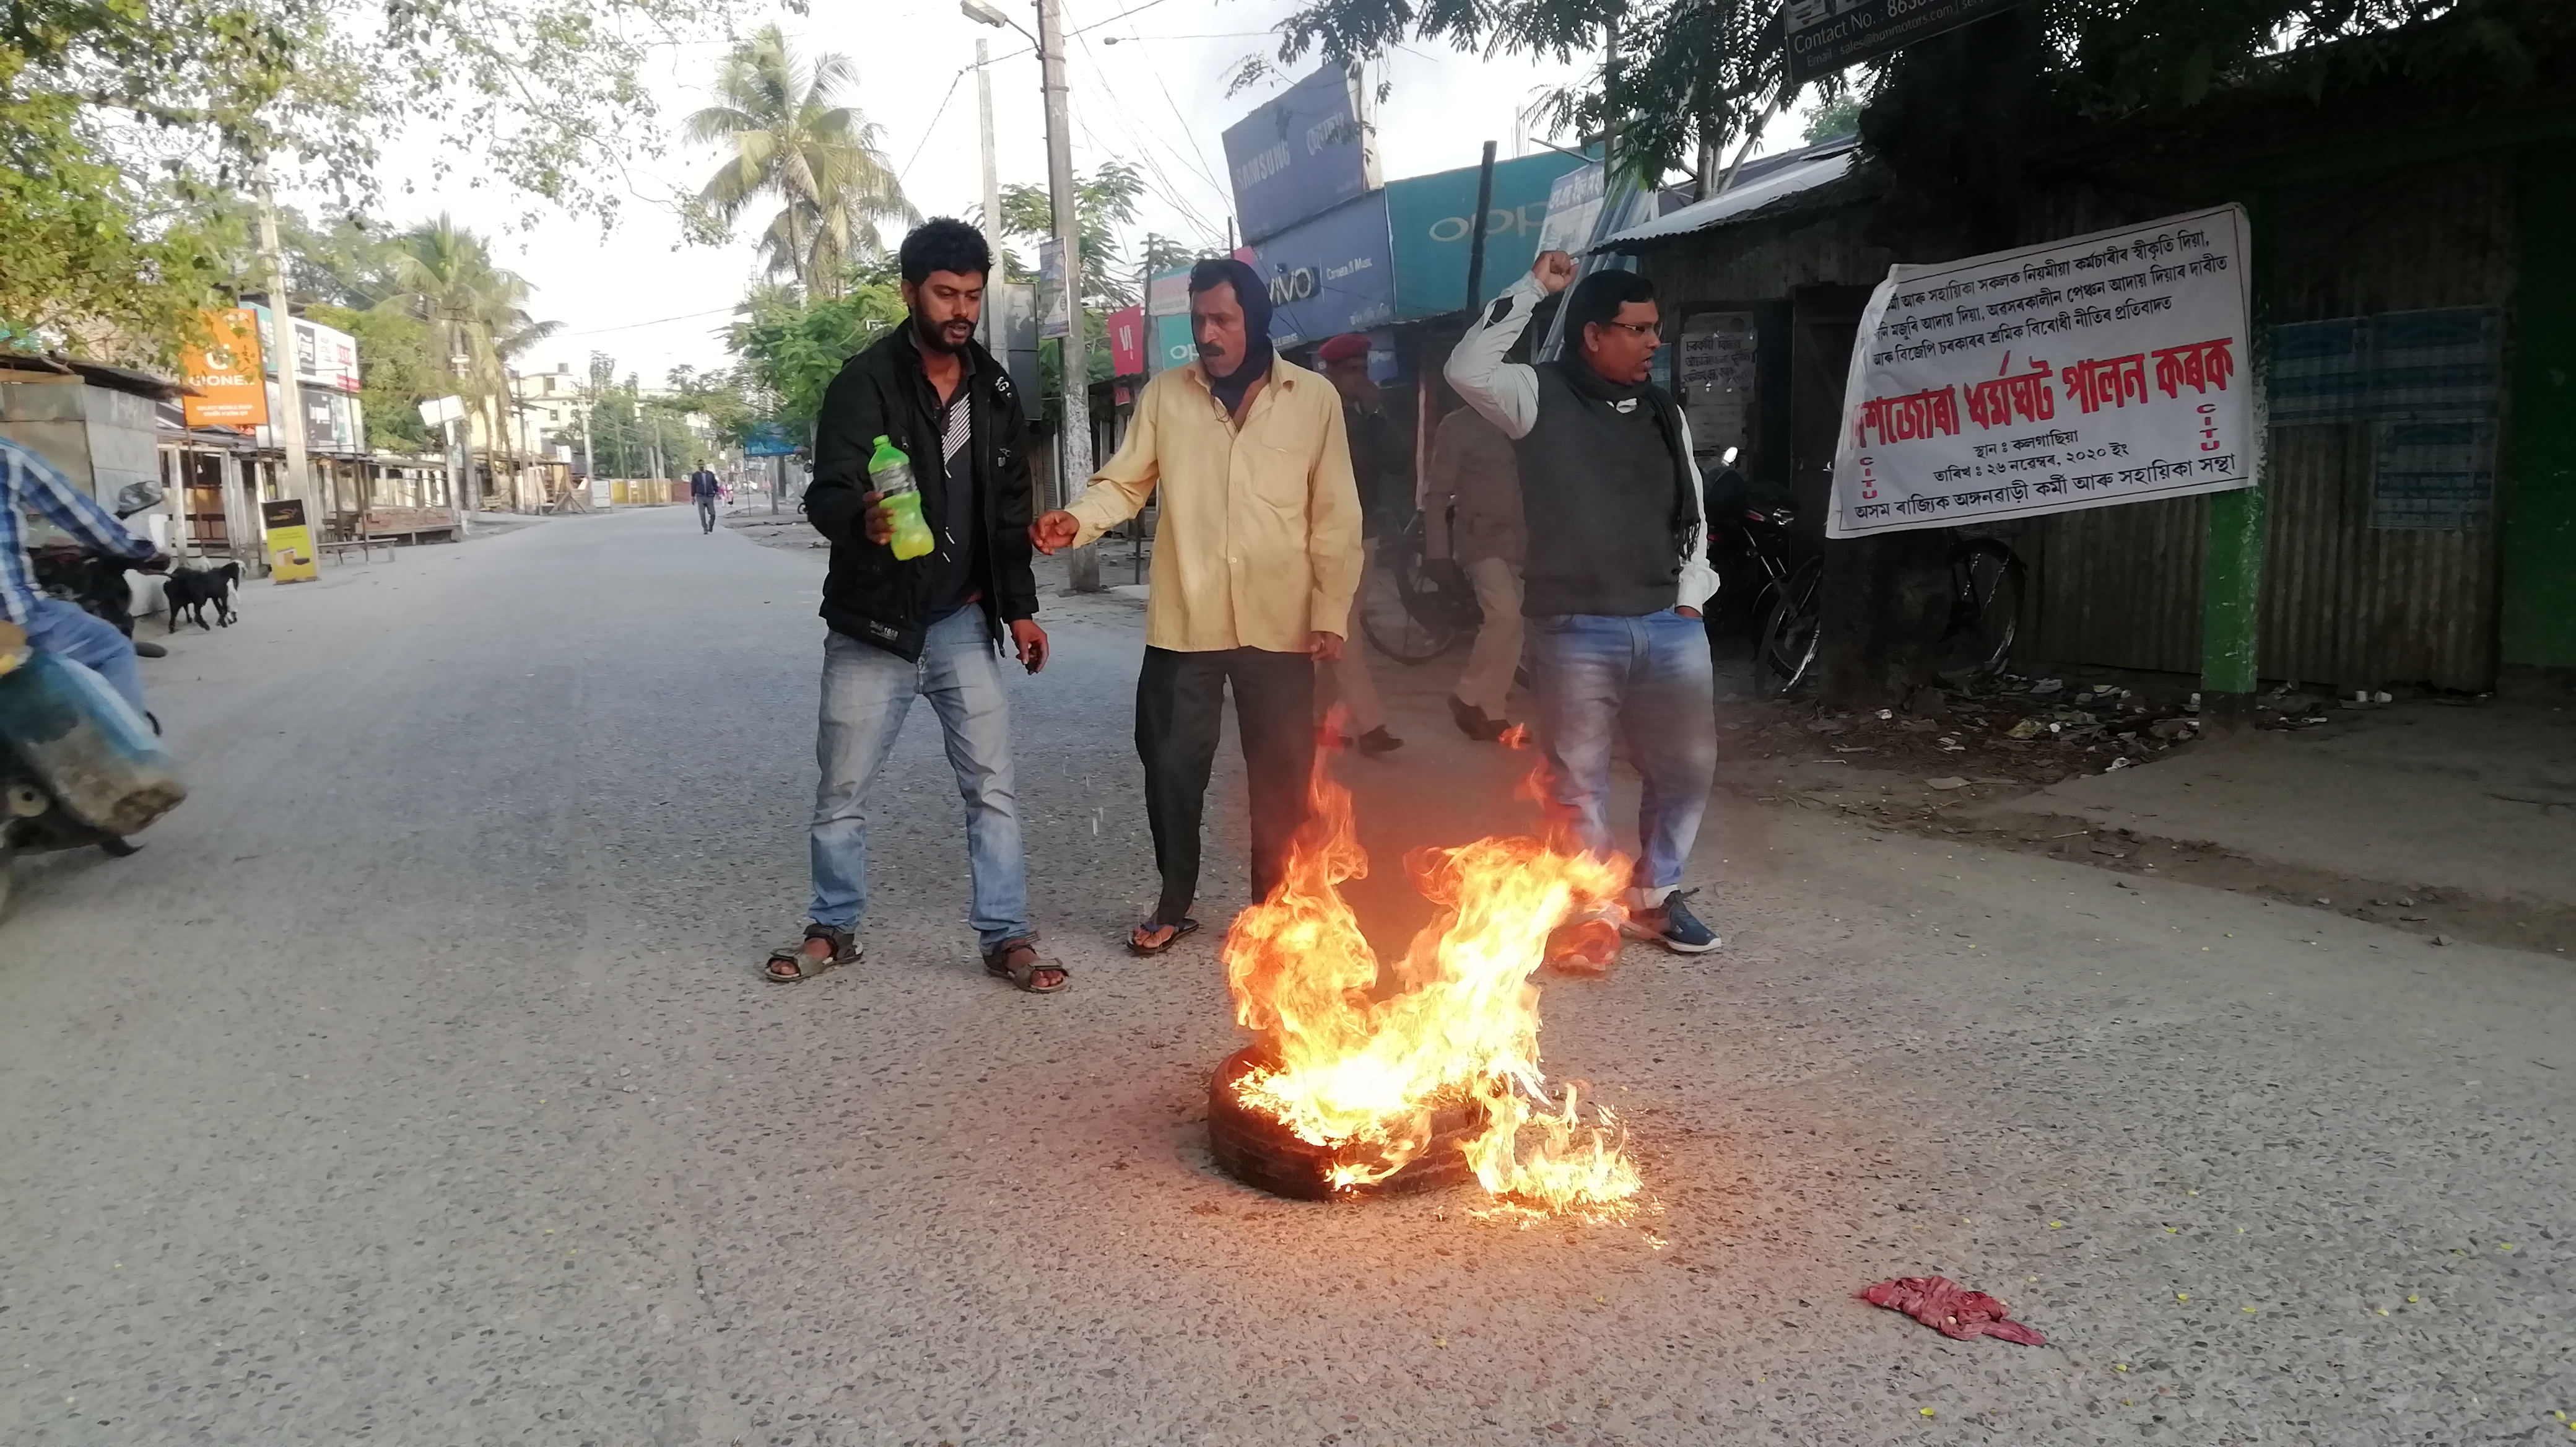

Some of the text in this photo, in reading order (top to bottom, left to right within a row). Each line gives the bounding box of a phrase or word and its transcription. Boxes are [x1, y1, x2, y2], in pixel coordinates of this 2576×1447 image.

[1794, 20, 1848, 55] Contact
[1850, 11, 1876, 32] No.
[1806, 50, 1833, 67] Email
[1235, 140, 1291, 191] SAMSUNG
[1429, 201, 1548, 242] OPP
[1901, 292, 1925, 307] আৰু
[1928, 280, 1975, 302] সহায়িকা
[1978, 271, 2021, 290] সকলক
[2073, 246, 2128, 271] কৰ্মচাৰীৰ
[1920, 312, 1953, 330] আদায়
[2108, 273, 2147, 292] আদায়
[2149, 264, 2186, 286] দিয়াৰ
[1895, 338, 1937, 362] বিজেপি
[2074, 305, 2112, 328] নীতিৰ
[2062, 353, 2148, 414] পালন
[2151, 338, 2234, 399] কৰক
[1933, 465, 1972, 482] তাৰিখ
[1988, 463, 2006, 476] ২৬
[2066, 448, 2107, 463] ২০২০
[1973, 442, 1997, 458] স্থান
[2011, 429, 2079, 451] কলগাছিয়া
[1854, 502, 1890, 519] অসম
[1894, 493, 1951, 517] ৰাজ্যিক
[2033, 473, 2068, 497] কৰ্মী
[2071, 473, 2114, 491] আৰু
[2118, 459, 2193, 485] সহায়িকা
